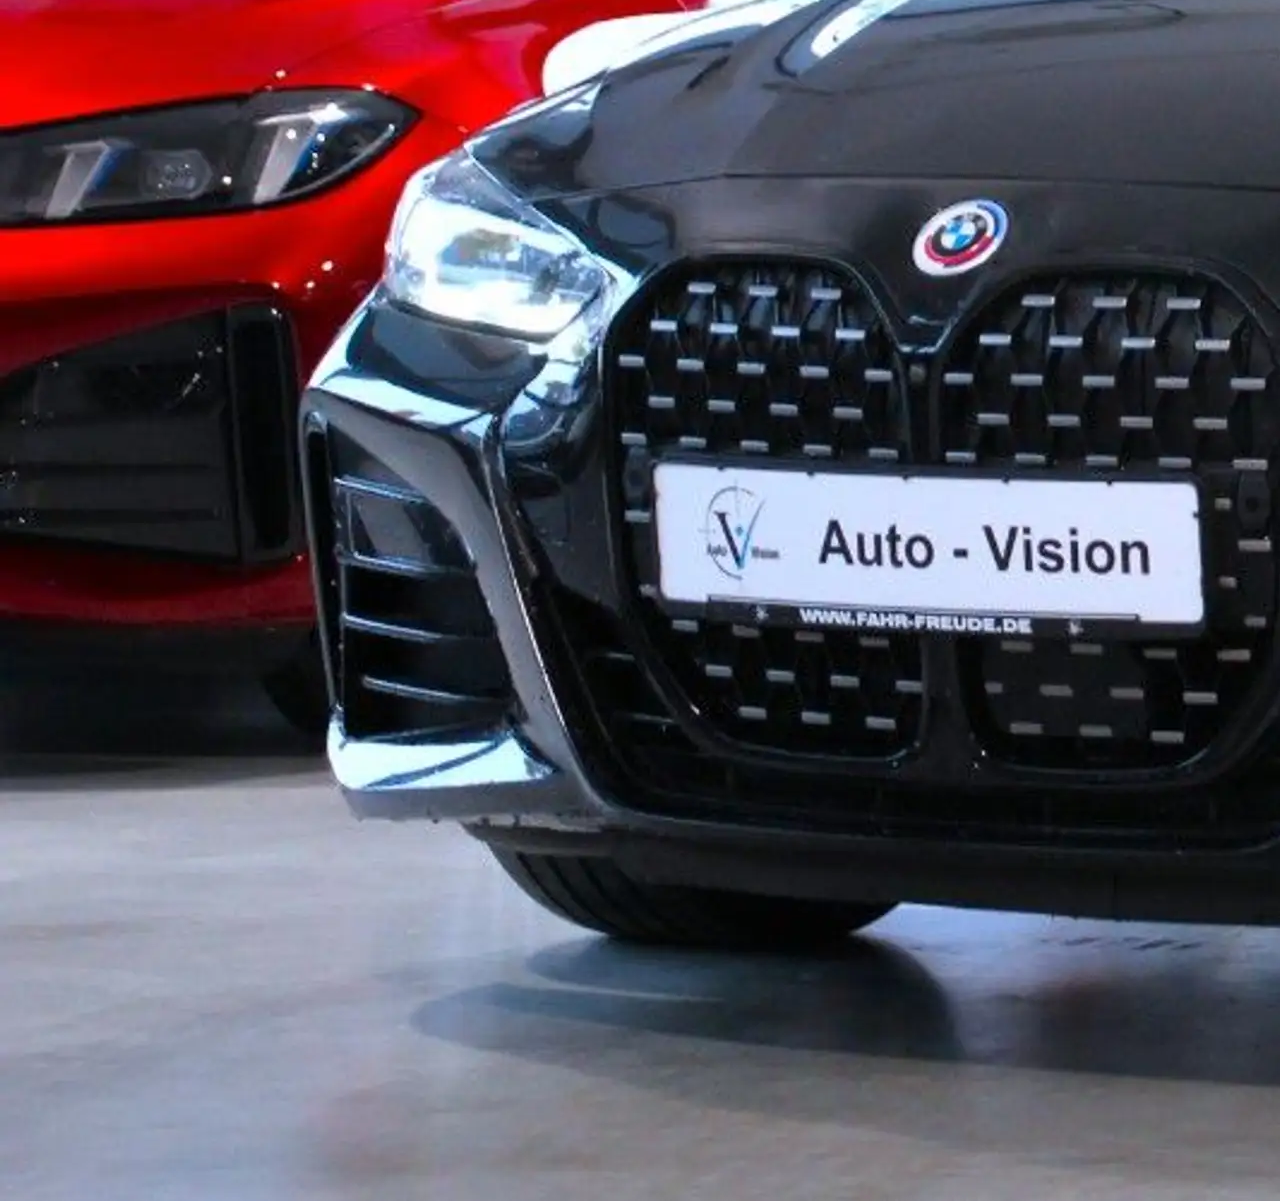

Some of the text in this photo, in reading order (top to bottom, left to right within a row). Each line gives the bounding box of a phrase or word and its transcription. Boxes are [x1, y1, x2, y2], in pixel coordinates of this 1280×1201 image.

[818, 519, 935, 569] Auto
[982, 524, 1151, 576] Vision
[799, 607, 1033, 635] WWW.FAHR-FREUDE.DE
